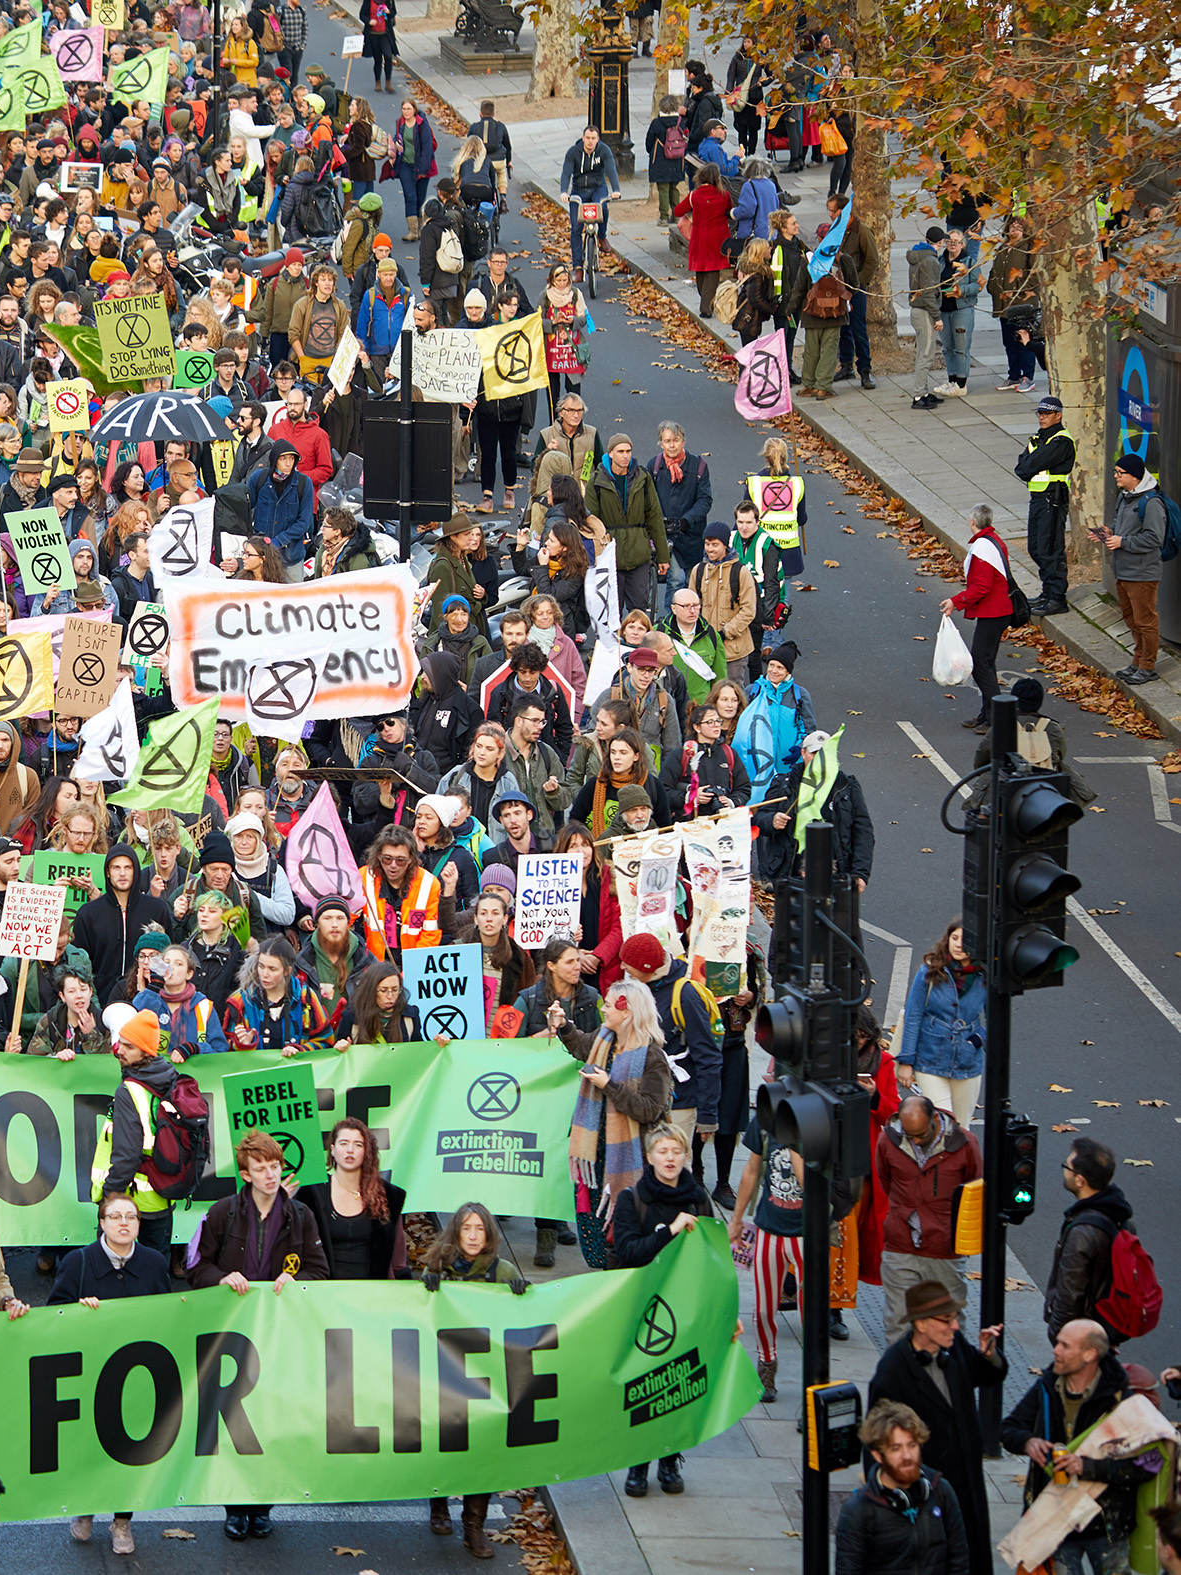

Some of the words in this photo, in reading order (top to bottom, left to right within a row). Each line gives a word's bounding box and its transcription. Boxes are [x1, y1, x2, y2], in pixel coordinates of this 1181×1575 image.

[95, 302, 113, 317] IT'S
[114, 298, 133, 314] NOT
[134, 295, 161, 312] FINE
[109, 349, 137, 364] STOP
[140, 345, 171, 360] LYING
[421, 349, 437, 359] our
[109, 364, 129, 380] DO
[552, 360, 579, 370] EARTH
[52, 386, 82, 398] PROTECT
[420, 375, 452, 393] SAVE
[455, 382, 470, 394] IT
[50, 400, 86, 421] LINCOLNSHIRE
[1128, 399, 1142, 422] RIVER
[21, 519, 48, 534] NON
[15, 532, 62, 550] VIOLENT
[215, 593, 380, 640] Climate
[68, 619, 117, 638] NATURE
[190, 646, 403, 694] Emency
[525, 859, 579, 878] LISTEN
[10, 886, 27, 895] THE
[30, 888, 63, 898] SCIENCE
[536, 879, 549, 889] TO
[552, 877, 570, 889] THE
[7, 895, 17, 903] IS
[20, 896, 59, 907] EVIDENT.
[521, 888, 580, 907] SCIENCE
[5, 912, 60, 925] TECHNOLOGY
[20, 905, 39, 914] HAVE
[44, 908, 59, 916] THE
[521, 908, 540, 919] NOT
[544, 907, 570, 918] YOUR
[5, 921, 32, 932] NOW
[35, 924, 53, 935] WE
[520, 919, 553, 931] MONEY
[0, 932, 32, 943] NEED
[38, 935, 53, 945] TO
[520, 930, 545, 944] GOD
[10, 943, 43, 956] ACT
[424, 952, 461, 974] ACT
[417, 976, 468, 1000] NOW
[242, 1080, 298, 1107] REBEL
[232, 1105, 270, 1130] FOR
[277, 1100, 314, 1124] LIFE
[440, 1130, 524, 1151] extinction
[463, 1149, 541, 1175] rebellion
[627, 1358, 692, 1403] extinction
[29, 1331, 263, 1475] FOR
[324, 1323, 560, 1455] LIFE
[649, 1377, 706, 1418] rebellion
